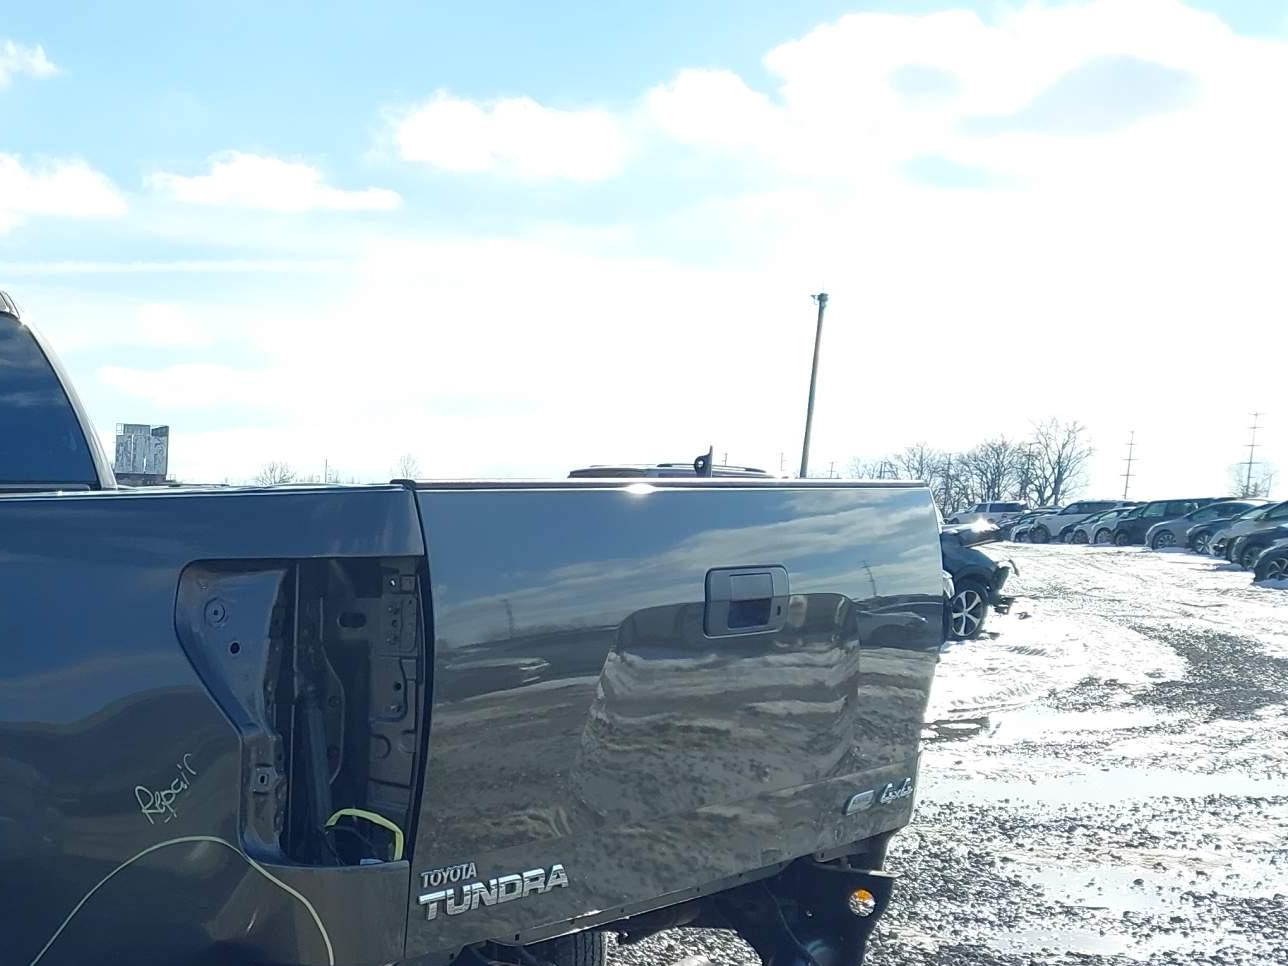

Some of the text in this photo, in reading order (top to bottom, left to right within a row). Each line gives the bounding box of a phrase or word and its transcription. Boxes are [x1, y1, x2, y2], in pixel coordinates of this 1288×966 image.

[134, 752, 197, 825] Repair
[418, 863, 570, 921] TUNDRA
[420, 862, 478, 889] TOYOTA
